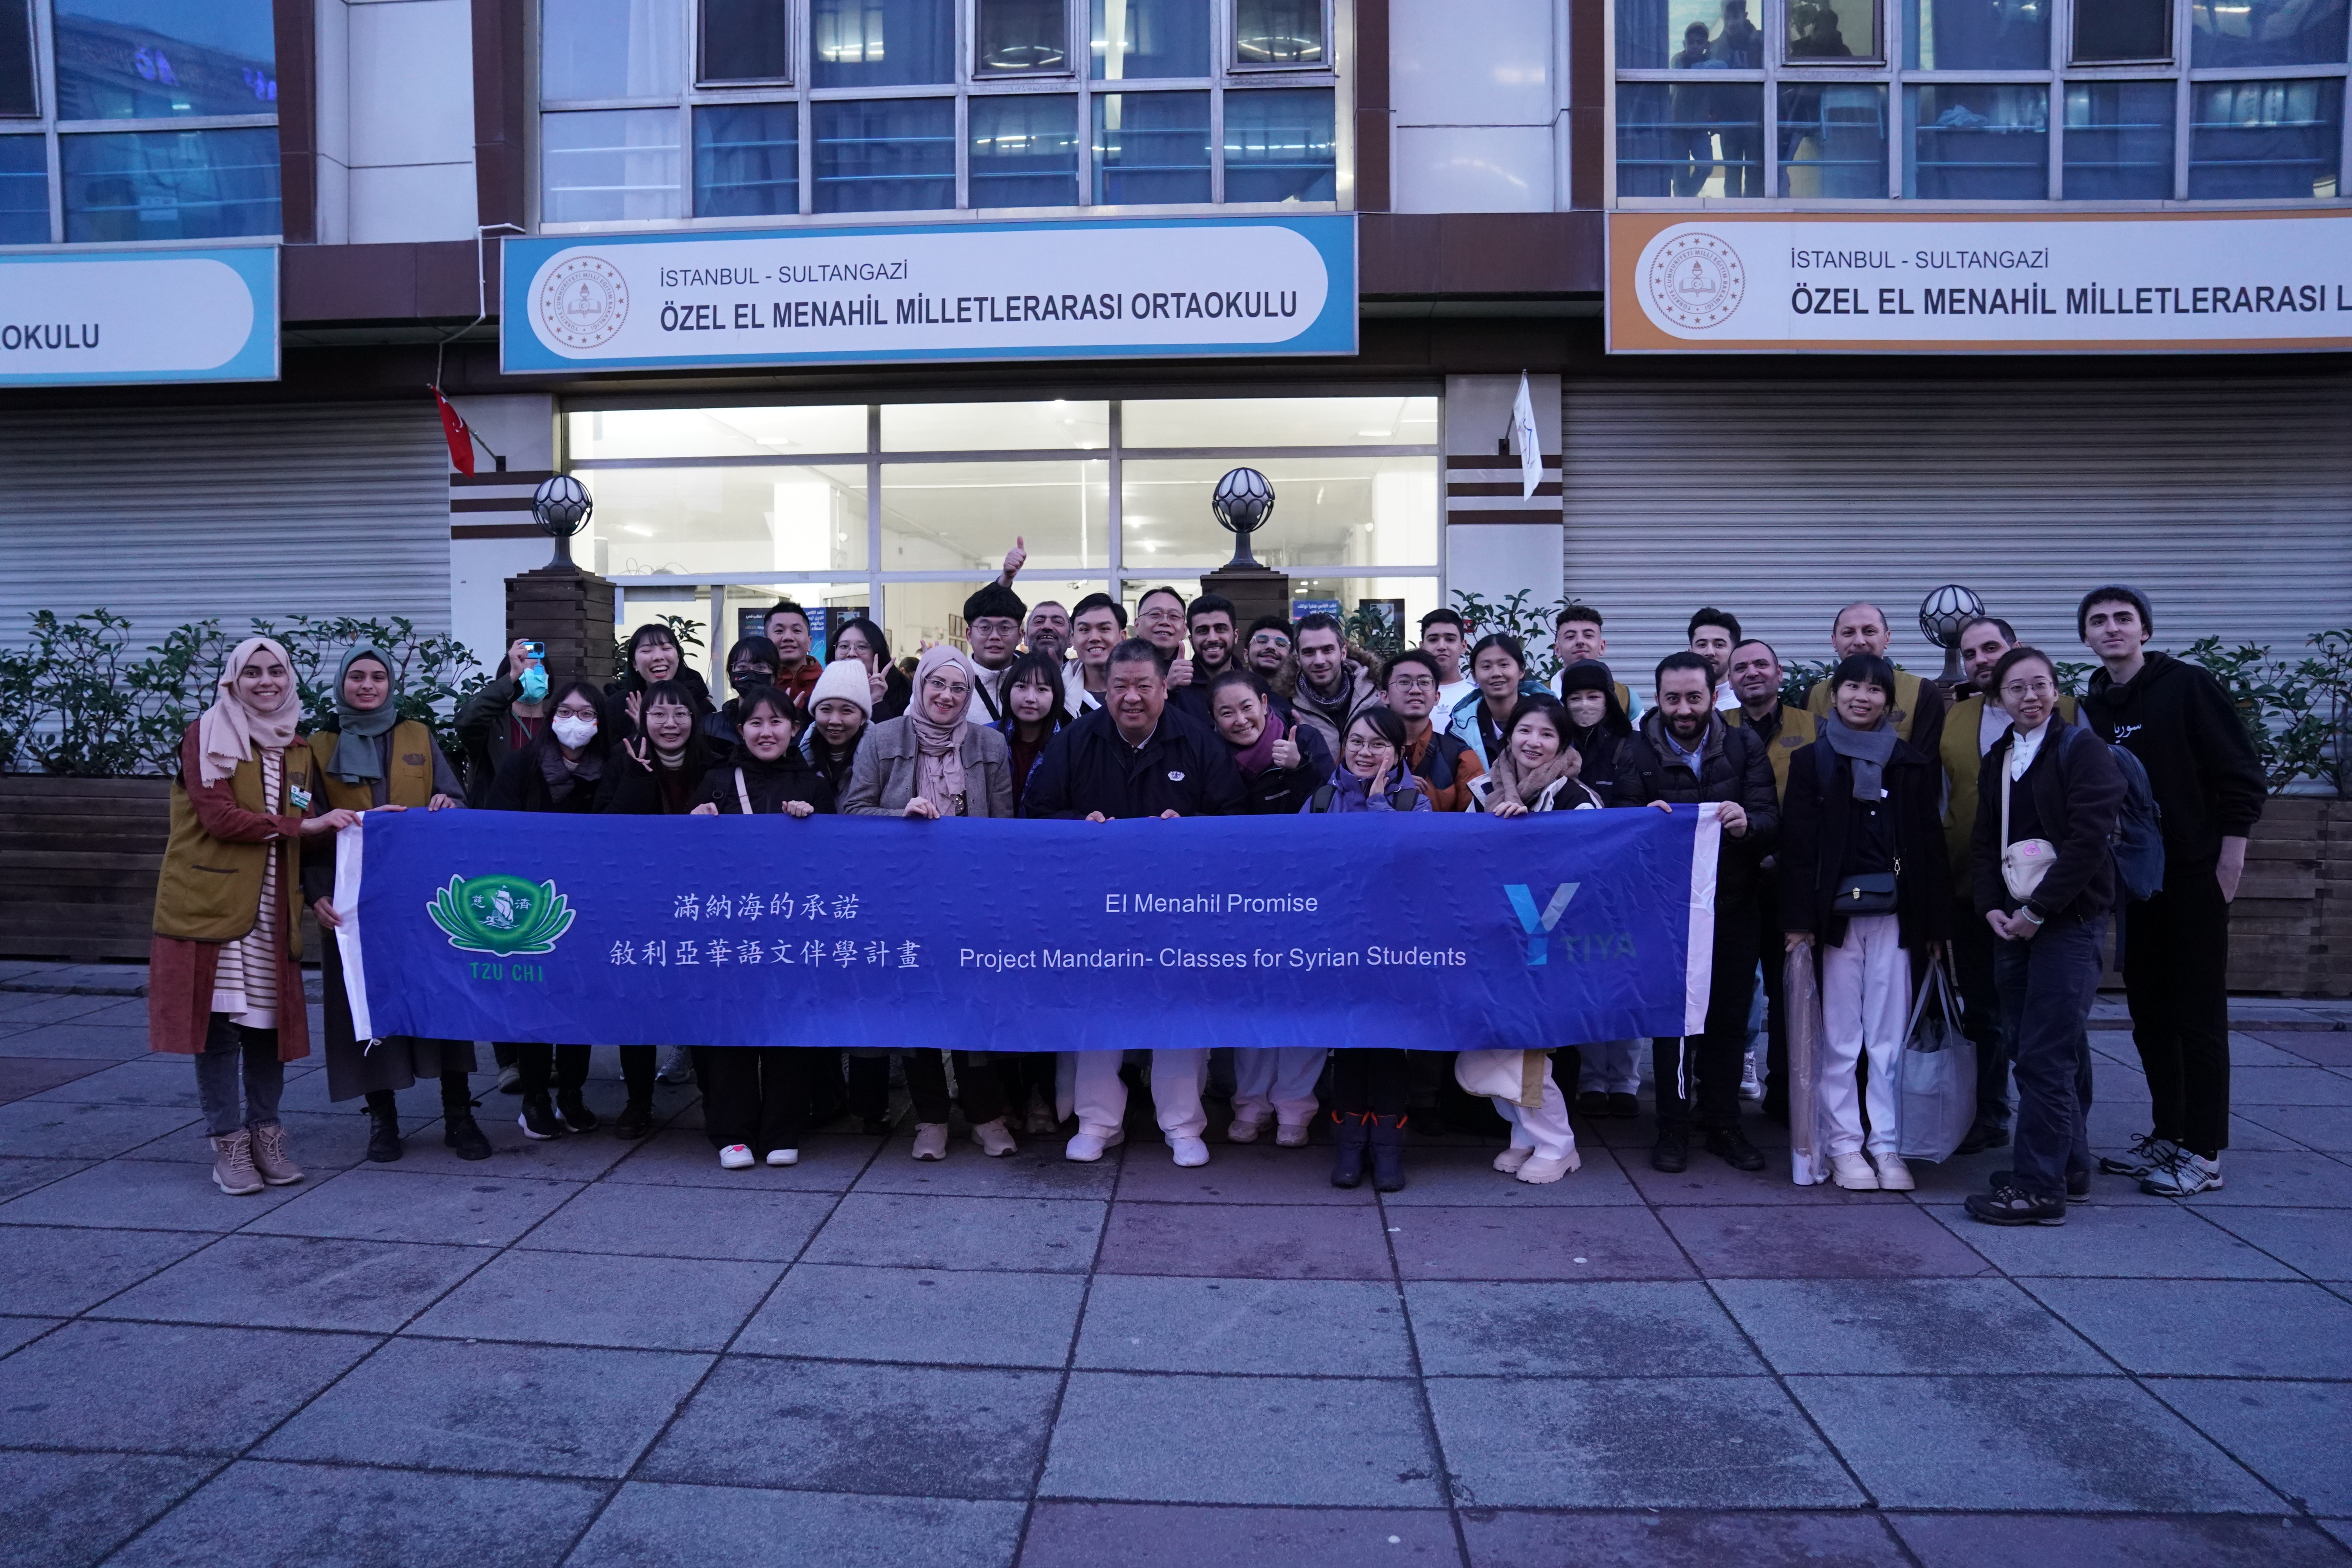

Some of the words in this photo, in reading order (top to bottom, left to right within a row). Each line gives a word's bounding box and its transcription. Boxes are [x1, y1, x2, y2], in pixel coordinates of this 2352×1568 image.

[1666, 250, 1693, 288] CUMHURİYETİ
[1792, 248, 1896, 269] İSTANBUL
[1916, 248, 2049, 269] SULTANGAZİ
[661, 268, 759, 287] İSTANBUL
[779, 259, 907, 283] SULTANGAZİ
[661, 301, 726, 331] ÖZEL
[735, 304, 765, 329] EL
[774, 294, 888, 328] MENAHİL
[897, 292, 1122, 324] MİLLETLERARASI
[1132, 291, 1297, 319] ORTAOKULU
[1668, 290, 1691, 311] TÜRKİYE
[1792, 283, 1869, 314] ÖZEL
[1880, 289, 1914, 314] EL
[1925, 283, 2056, 315] MENAHİL
[2067, 282, 2326, 314] MİLLETLERARASI
[0, 324, 99, 350] OKULU
[2114, 722, 2142, 744] سوريا
[471, 895, 485, 909] 慈
[515, 898, 532, 910] 濟
[674, 892, 859, 921] 滿納海的承諾
[1135, 894, 1220, 913] Menahil
[1228, 893, 1318, 913] Promise
[610, 939, 921, 969] 敘利亞華語文伴學計畫
[960, 948, 1036, 972] Project
[1044, 949, 1153, 967] Mandarin-
[1160, 948, 1247, 967] Classes
[1254, 949, 1283, 967] for
[1289, 948, 1359, 971] Syrian
[1367, 946, 1466, 966] Students
[1559, 933, 1637, 962] TIYA
[469, 962, 503, 981] TZU
[512, 964, 543, 982] CHI
